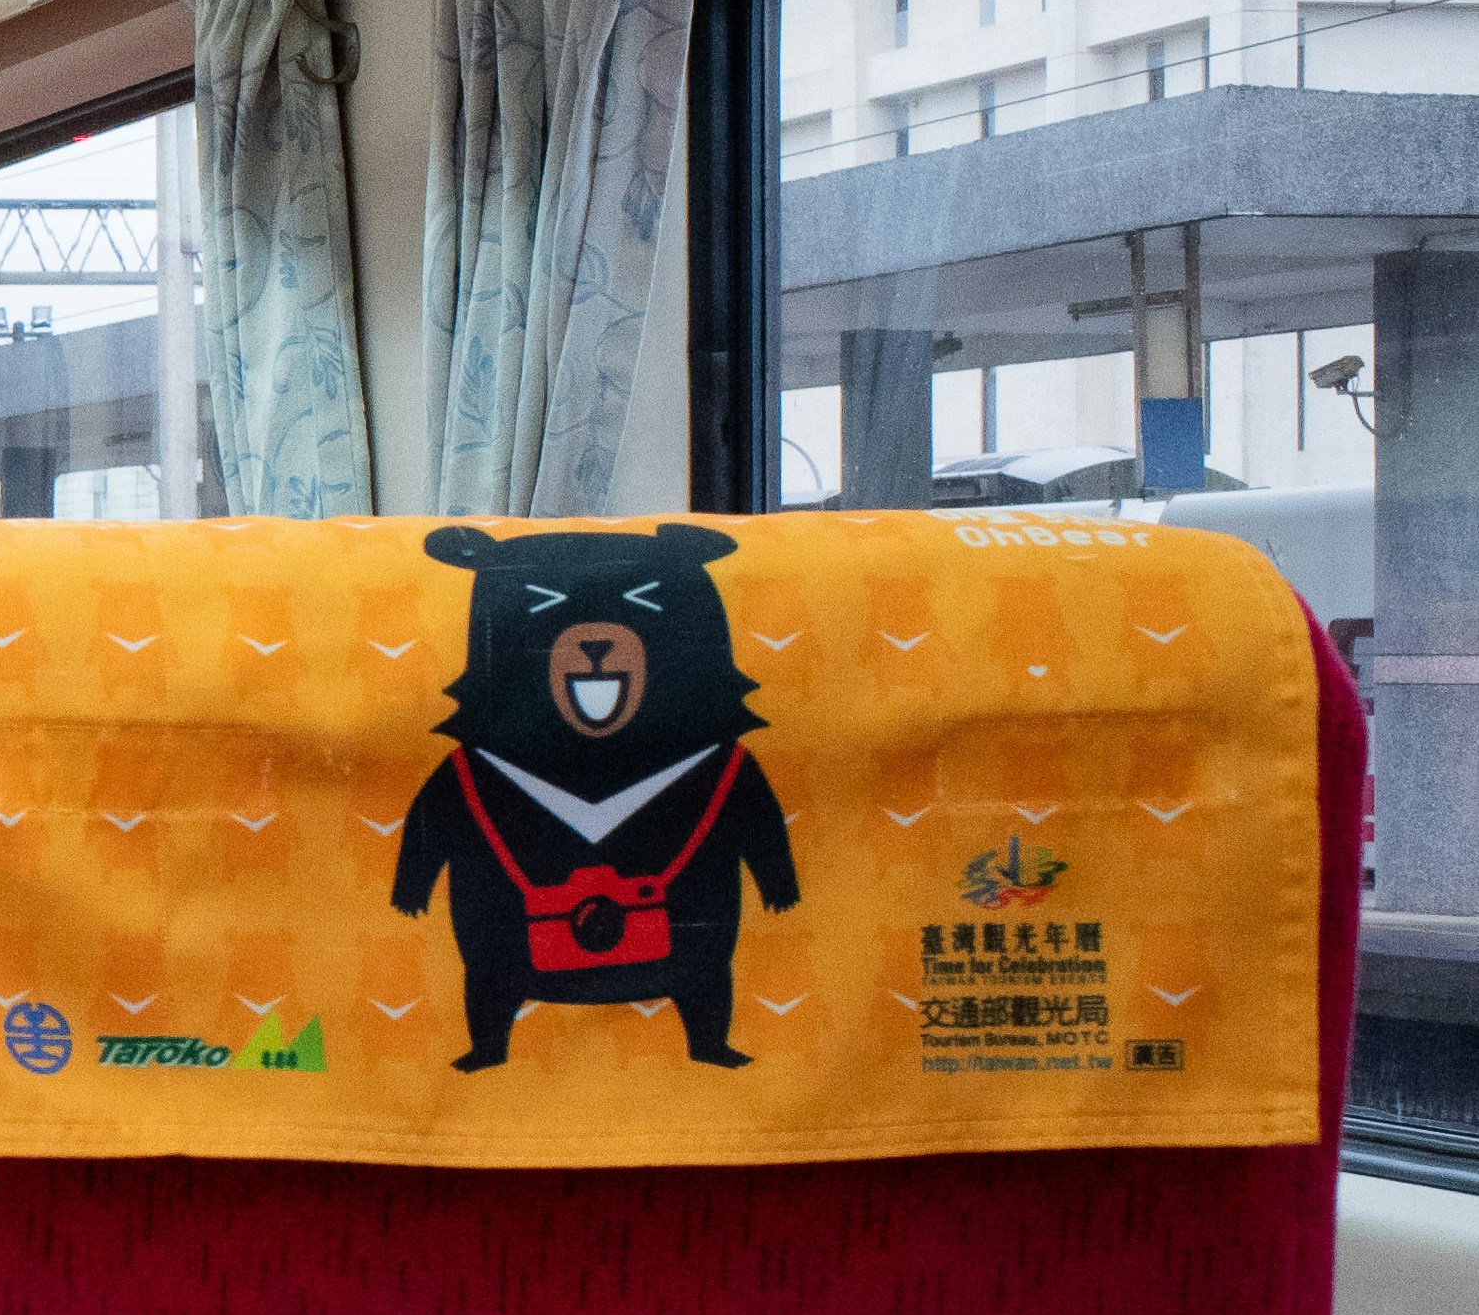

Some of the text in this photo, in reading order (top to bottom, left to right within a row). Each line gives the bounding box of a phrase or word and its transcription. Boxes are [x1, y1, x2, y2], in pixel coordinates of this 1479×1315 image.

[921, 995, 1109, 1029] 交通部觀光局
[97, 1035, 231, 1069] Taroko
